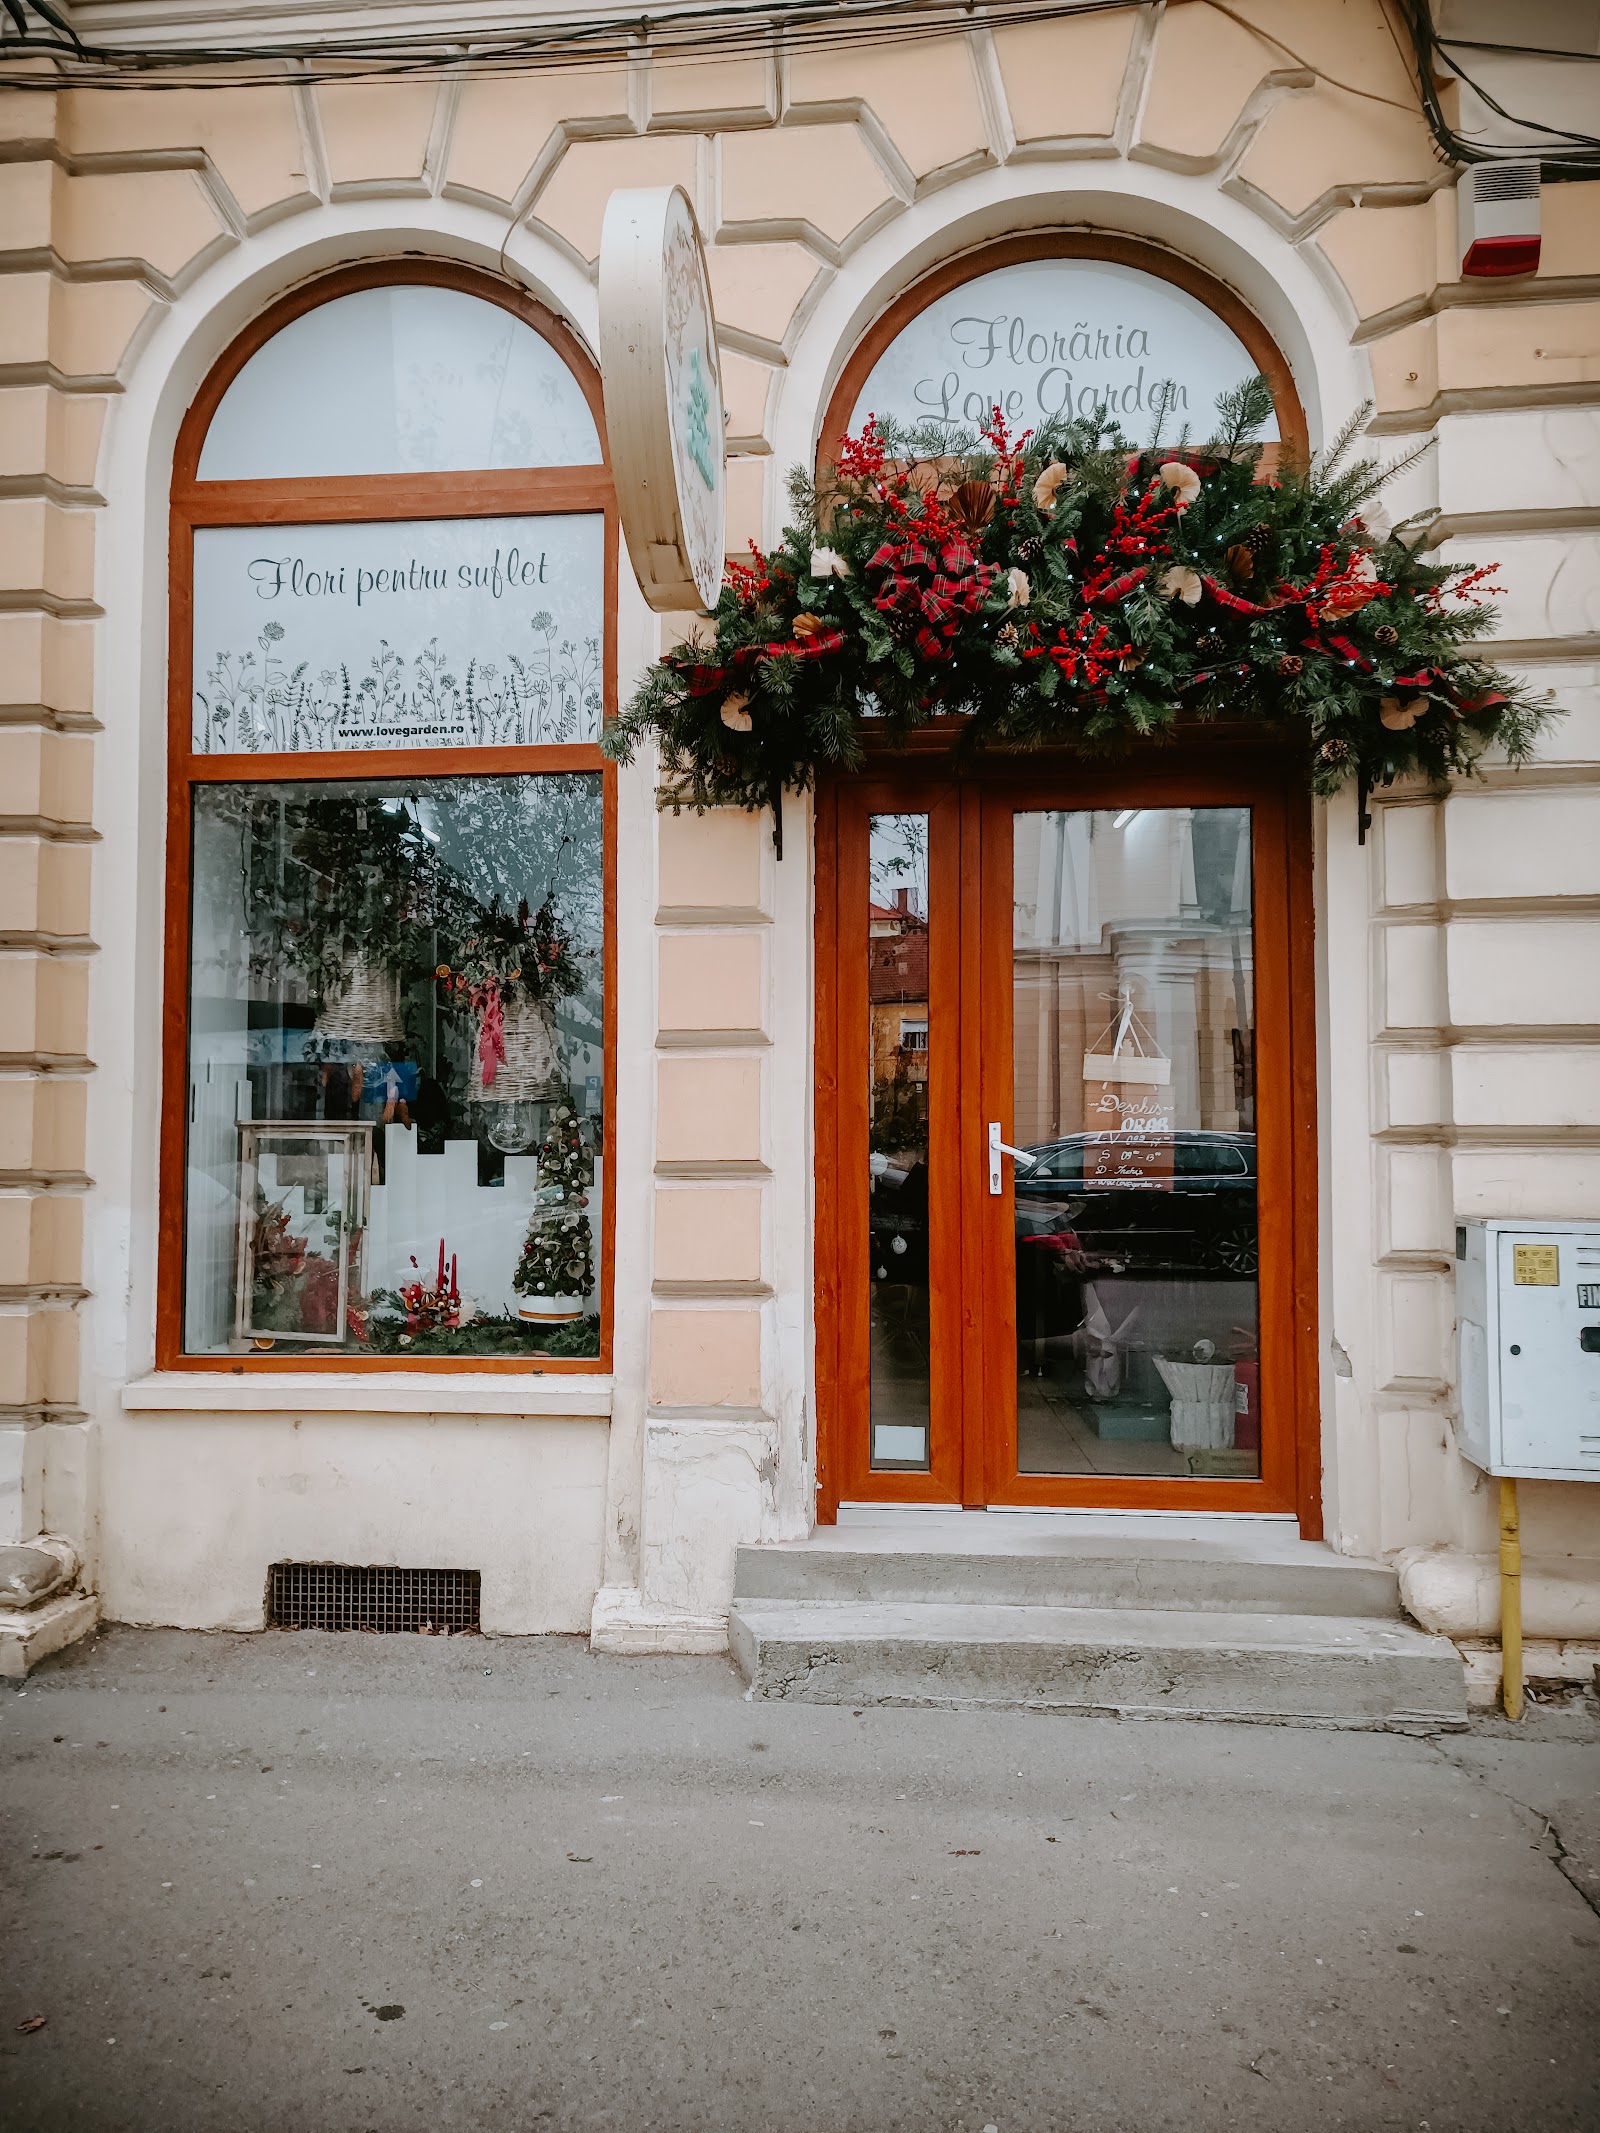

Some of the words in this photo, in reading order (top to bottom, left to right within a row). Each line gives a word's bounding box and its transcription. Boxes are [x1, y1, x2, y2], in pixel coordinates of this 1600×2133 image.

[914, 372, 1023, 427] Love
[1037, 366, 1189, 424] Garden
[248, 557, 347, 600] Flori
[357, 559, 448, 607] pentru
[457, 548, 549, 599] suflet
[338, 724, 465, 738] www.lovegarden.ro
[1096, 1094, 1162, 1116] Deschis
